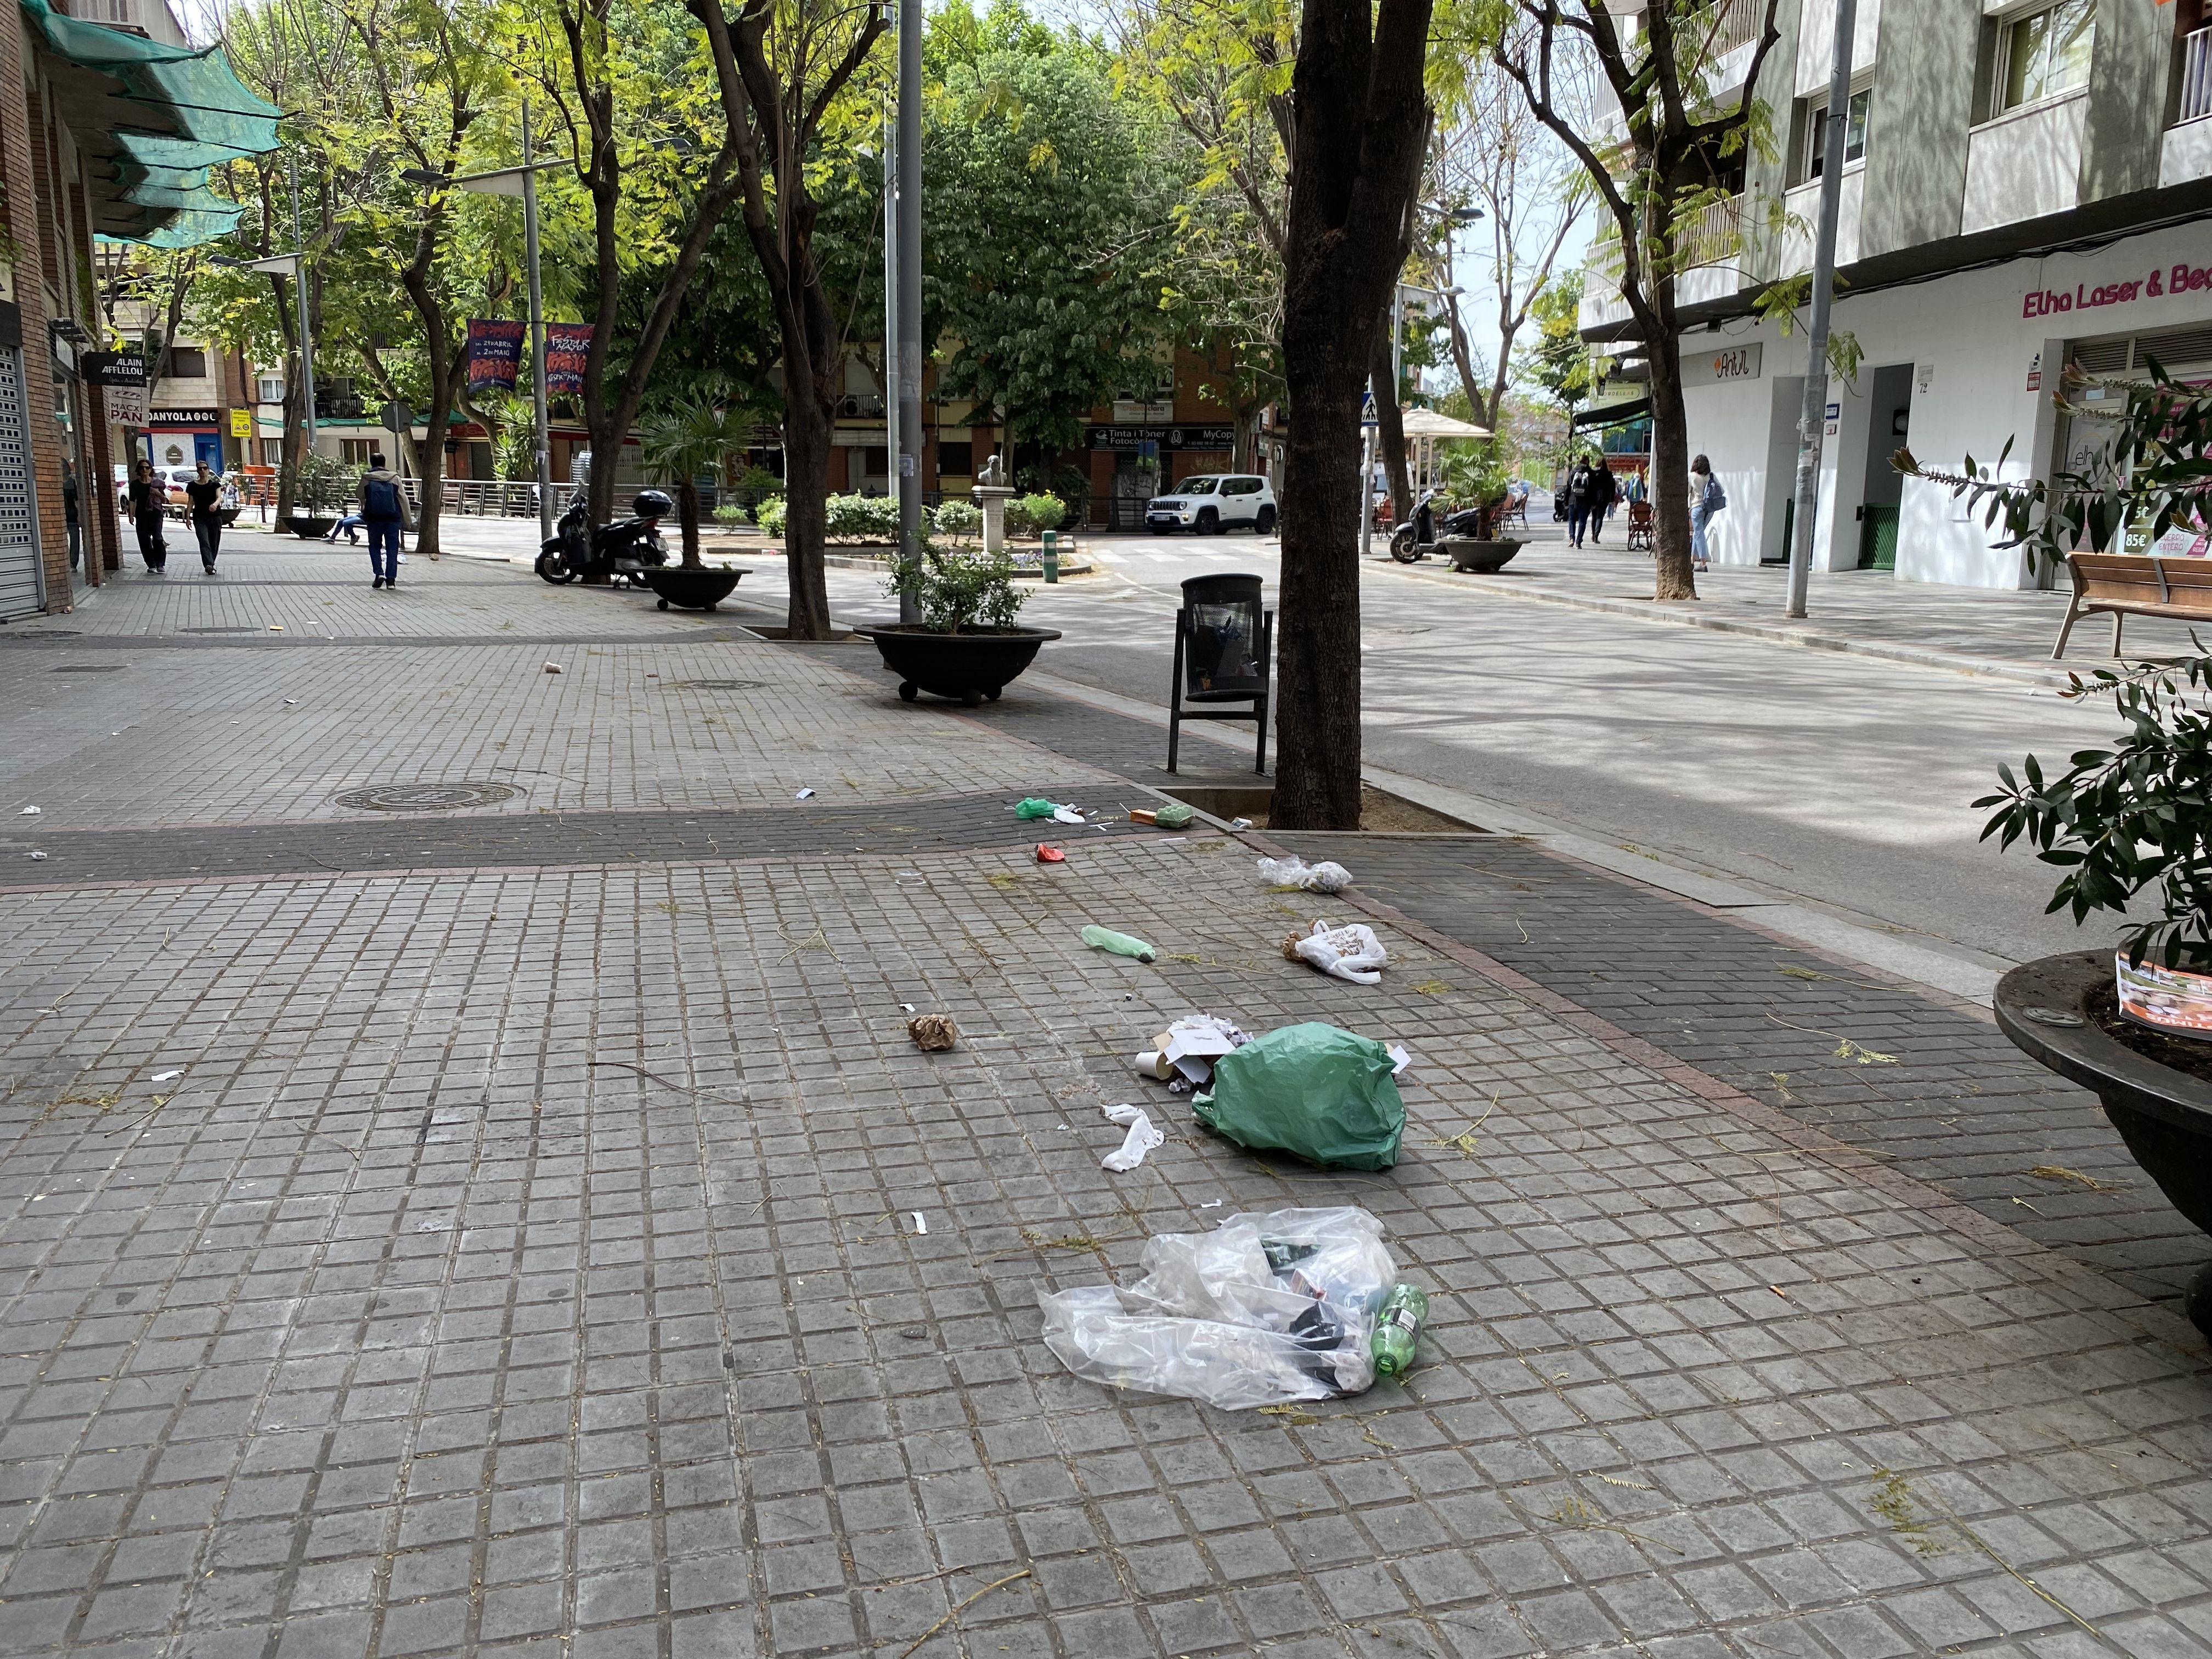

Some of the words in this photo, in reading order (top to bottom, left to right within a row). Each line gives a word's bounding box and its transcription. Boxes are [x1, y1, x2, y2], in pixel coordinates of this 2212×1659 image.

[2023, 290, 2072, 318] Elha
[2076, 280, 2143, 309] Laser
[2146, 270, 2163, 297] &
[116, 358, 142, 367] ALAIN
[102, 365, 143, 375] AFFLELOU
[1920, 382, 1928, 394] 72
[111, 403, 142, 413] MACXI
[111, 410, 143, 423] PAN
[2125, 533, 2147, 547] 85€
[2158, 542, 2183, 551] ENTERO
